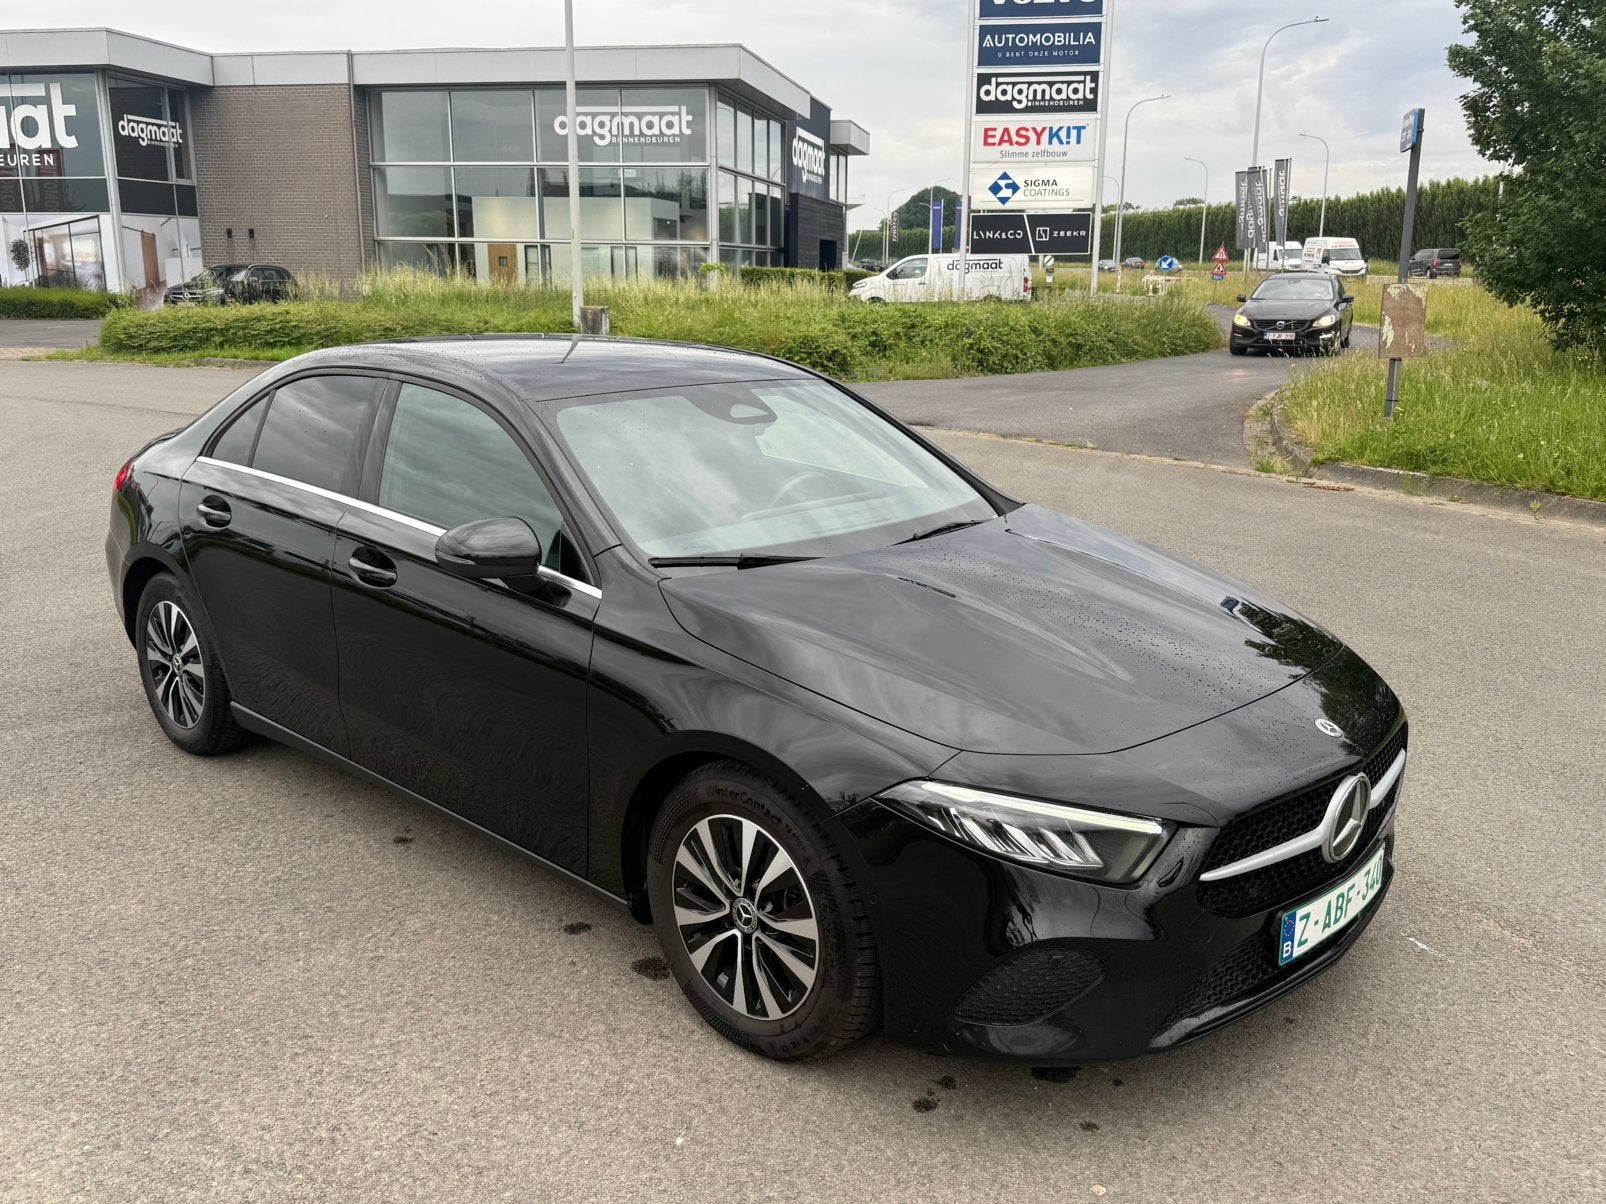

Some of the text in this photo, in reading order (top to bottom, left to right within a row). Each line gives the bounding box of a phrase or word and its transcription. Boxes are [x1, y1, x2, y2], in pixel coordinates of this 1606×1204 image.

[982, 32, 1096, 48] AUTOMOBILIA
[979, 75, 1096, 109] dagmaat
[118, 113, 183, 147] dagmaat
[792, 126, 826, 184] dagmaat
[1000, 149, 1068, 159] Slimme zelfbouw
[1023, 179, 1058, 188] SIGMA
[1023, 188, 1070, 197] COATINGS
[706, 785, 782, 825] WinterContact
[1283, 853, 1382, 957] B Z-ABF-340
